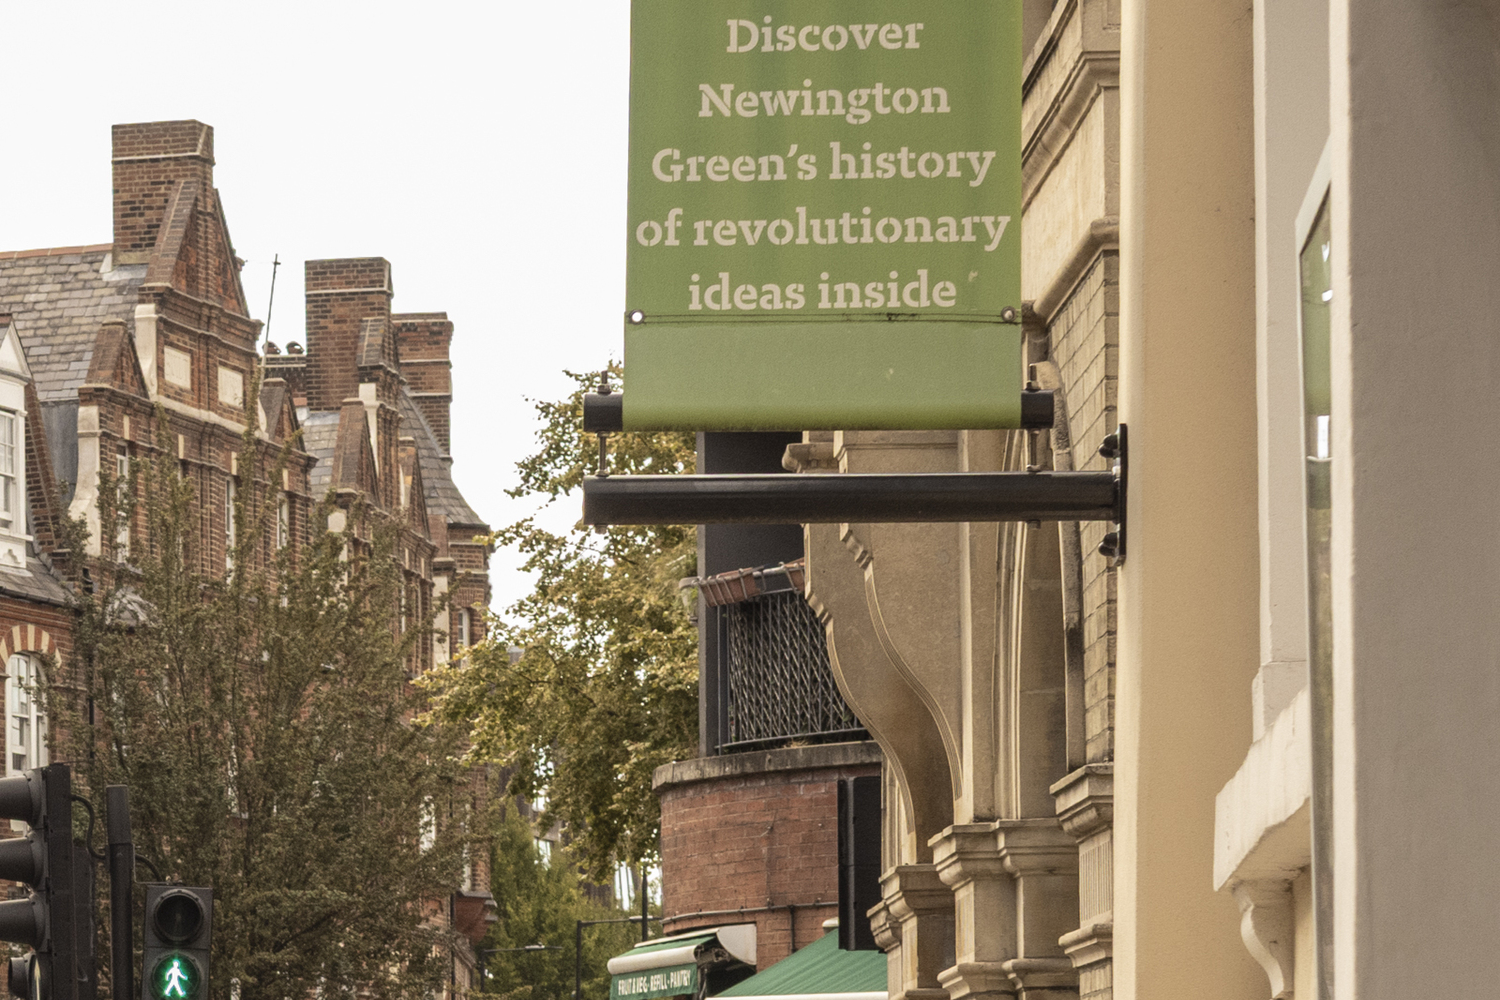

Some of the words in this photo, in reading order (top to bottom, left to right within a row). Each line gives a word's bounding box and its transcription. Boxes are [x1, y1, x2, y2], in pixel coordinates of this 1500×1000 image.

[726, 15, 924, 53] Discover
[698, 79, 950, 125] Newington
[829, 141, 996, 188] history
[635, 208, 683, 247] of
[693, 206, 1011, 252] revolutionary
[688, 272, 806, 311] ideas
[818, 268, 957, 310] inside
[650, 973, 668, 991] REFILL
[669, 969, 691, 988] PANTRY
